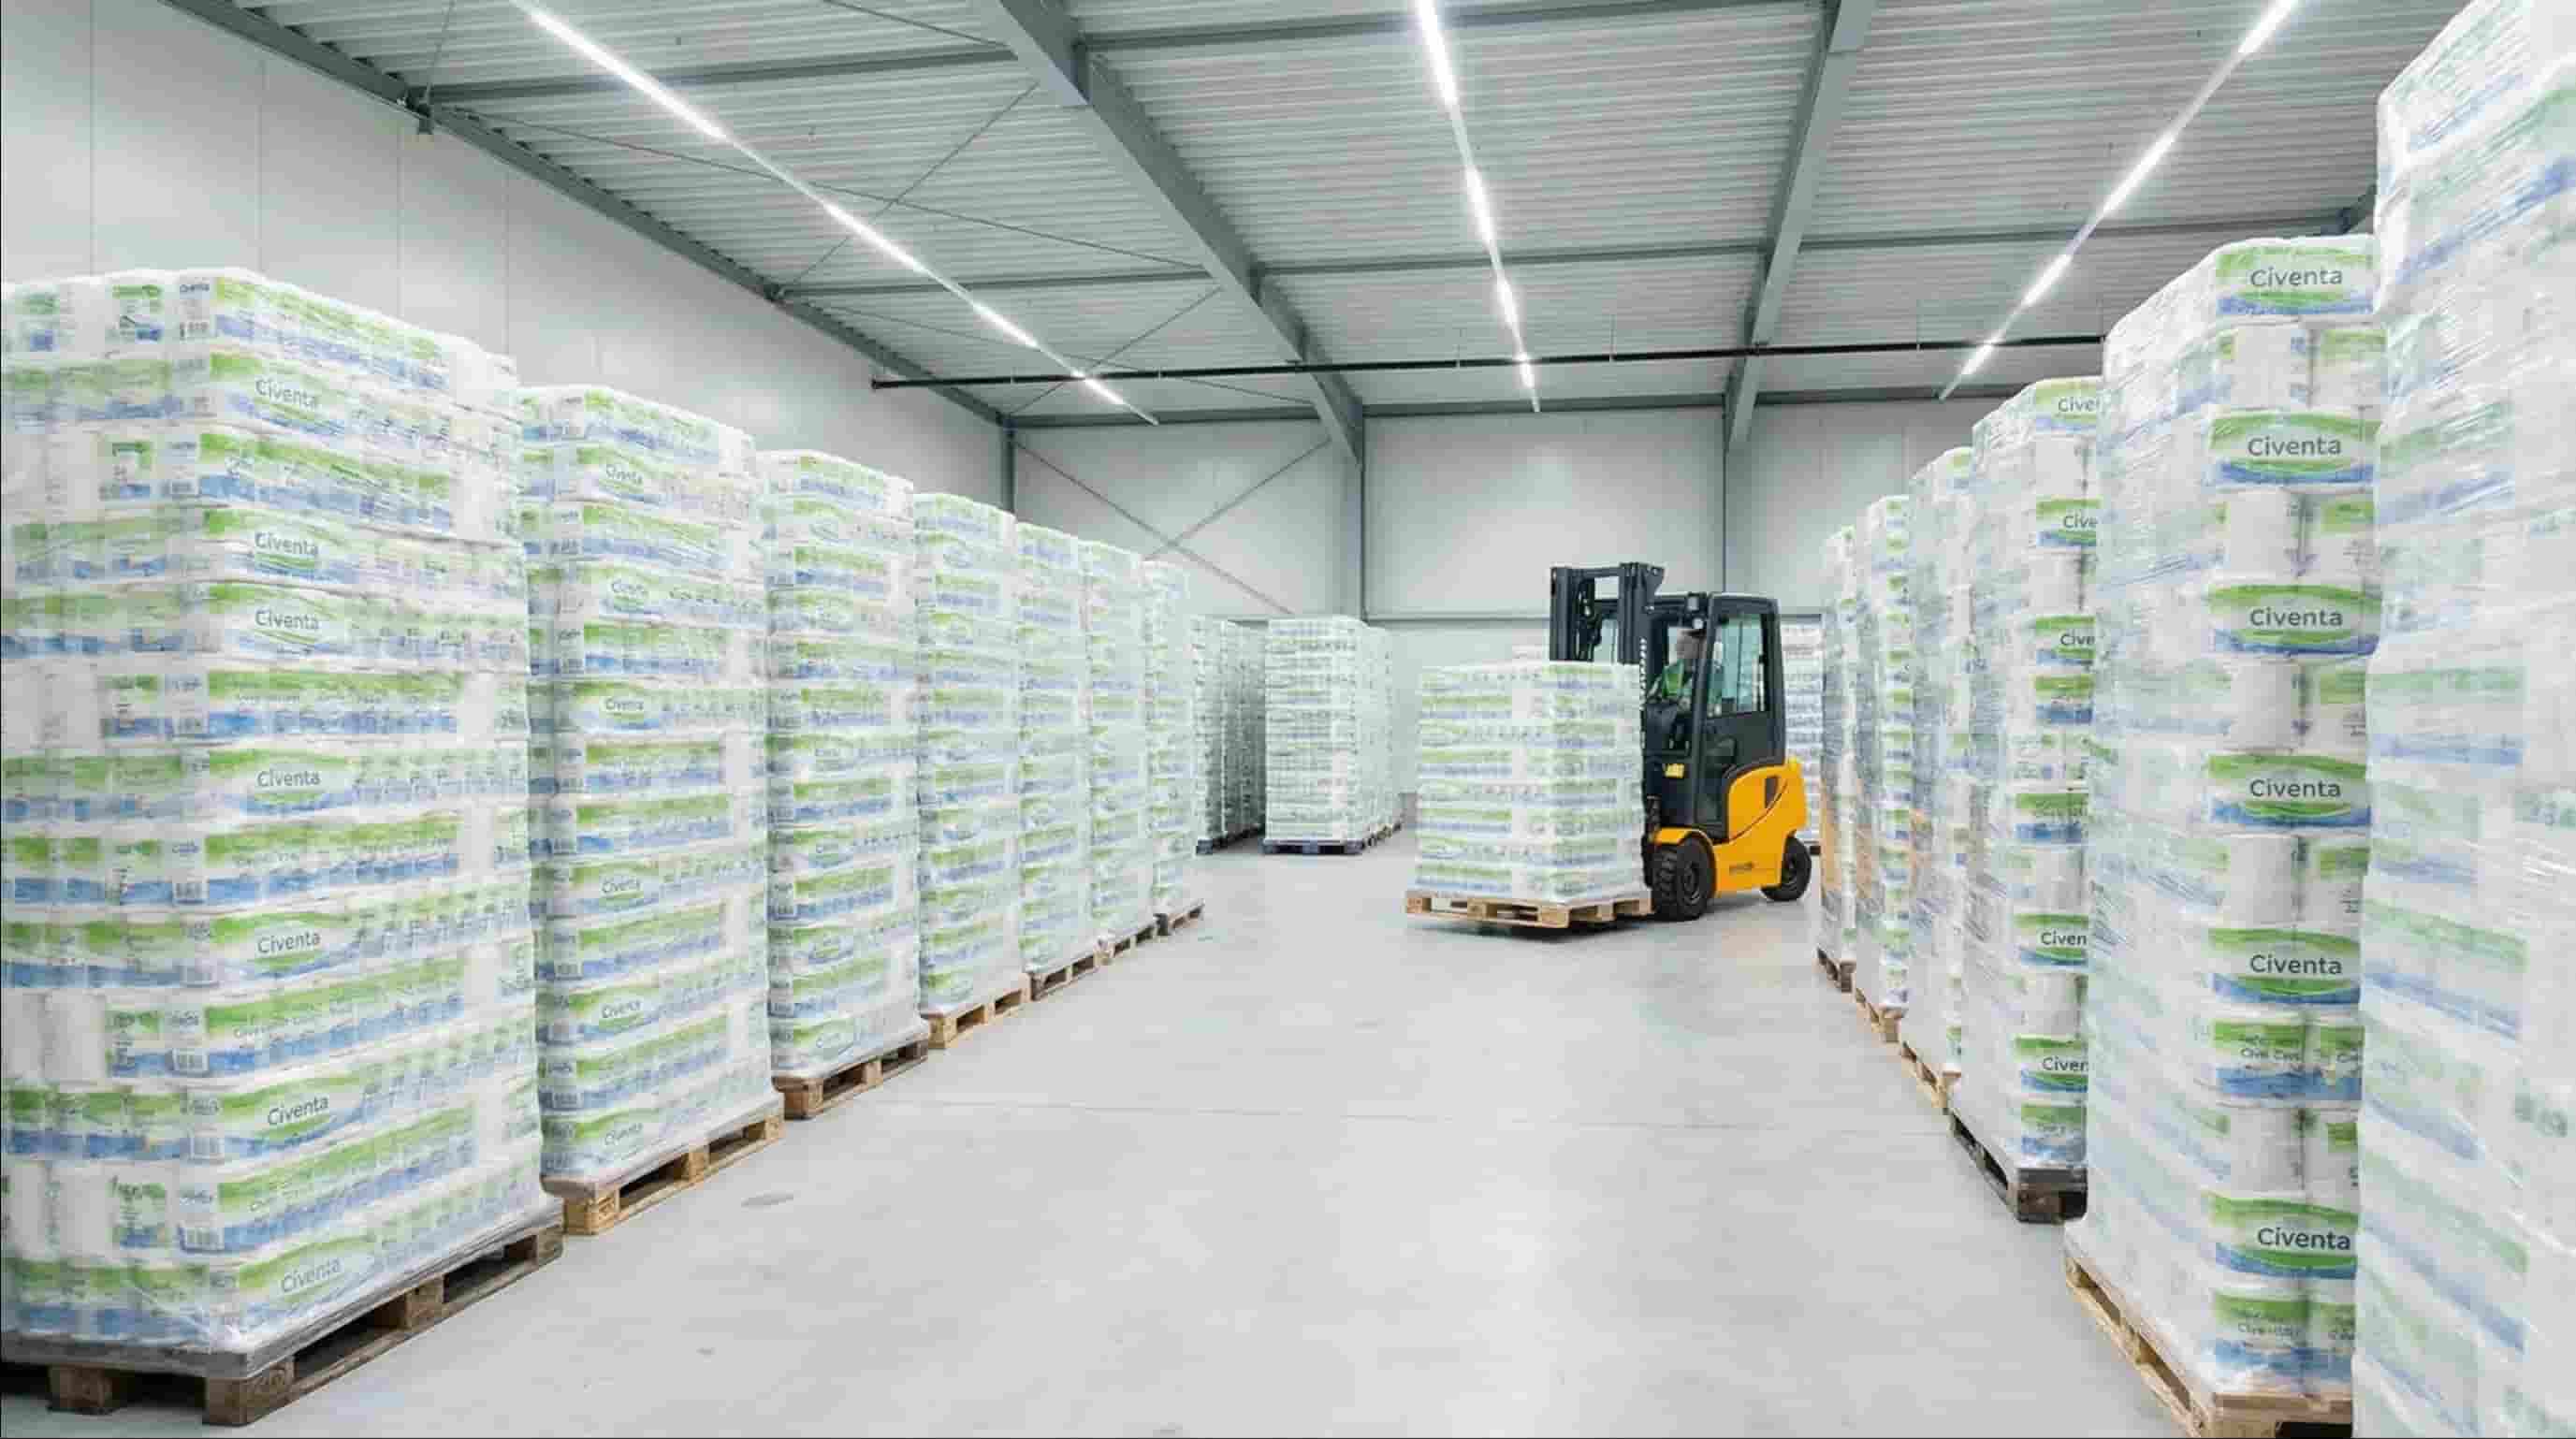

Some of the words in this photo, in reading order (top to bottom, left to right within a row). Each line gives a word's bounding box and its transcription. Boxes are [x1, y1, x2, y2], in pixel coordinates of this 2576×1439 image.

[2250, 267, 2343, 287] Civenta
[255, 380, 320, 408] Civenta
[2248, 435, 2341, 457] Civenta
[255, 532, 319, 557] Civenta
[255, 610, 319, 631] Civenta
[2249, 606, 2343, 627] Civenta
[257, 769, 321, 788] Civenta
[2249, 778, 2341, 798] Civenta
[257, 931, 321, 954] Civenta
[2041, 929, 2087, 945] Civen
[2249, 954, 2343, 975] Civenta
[268, 1096, 329, 1126] Civenta
[2257, 1227, 2350, 1251] Civenta
[282, 1257, 342, 1294] Civenta
